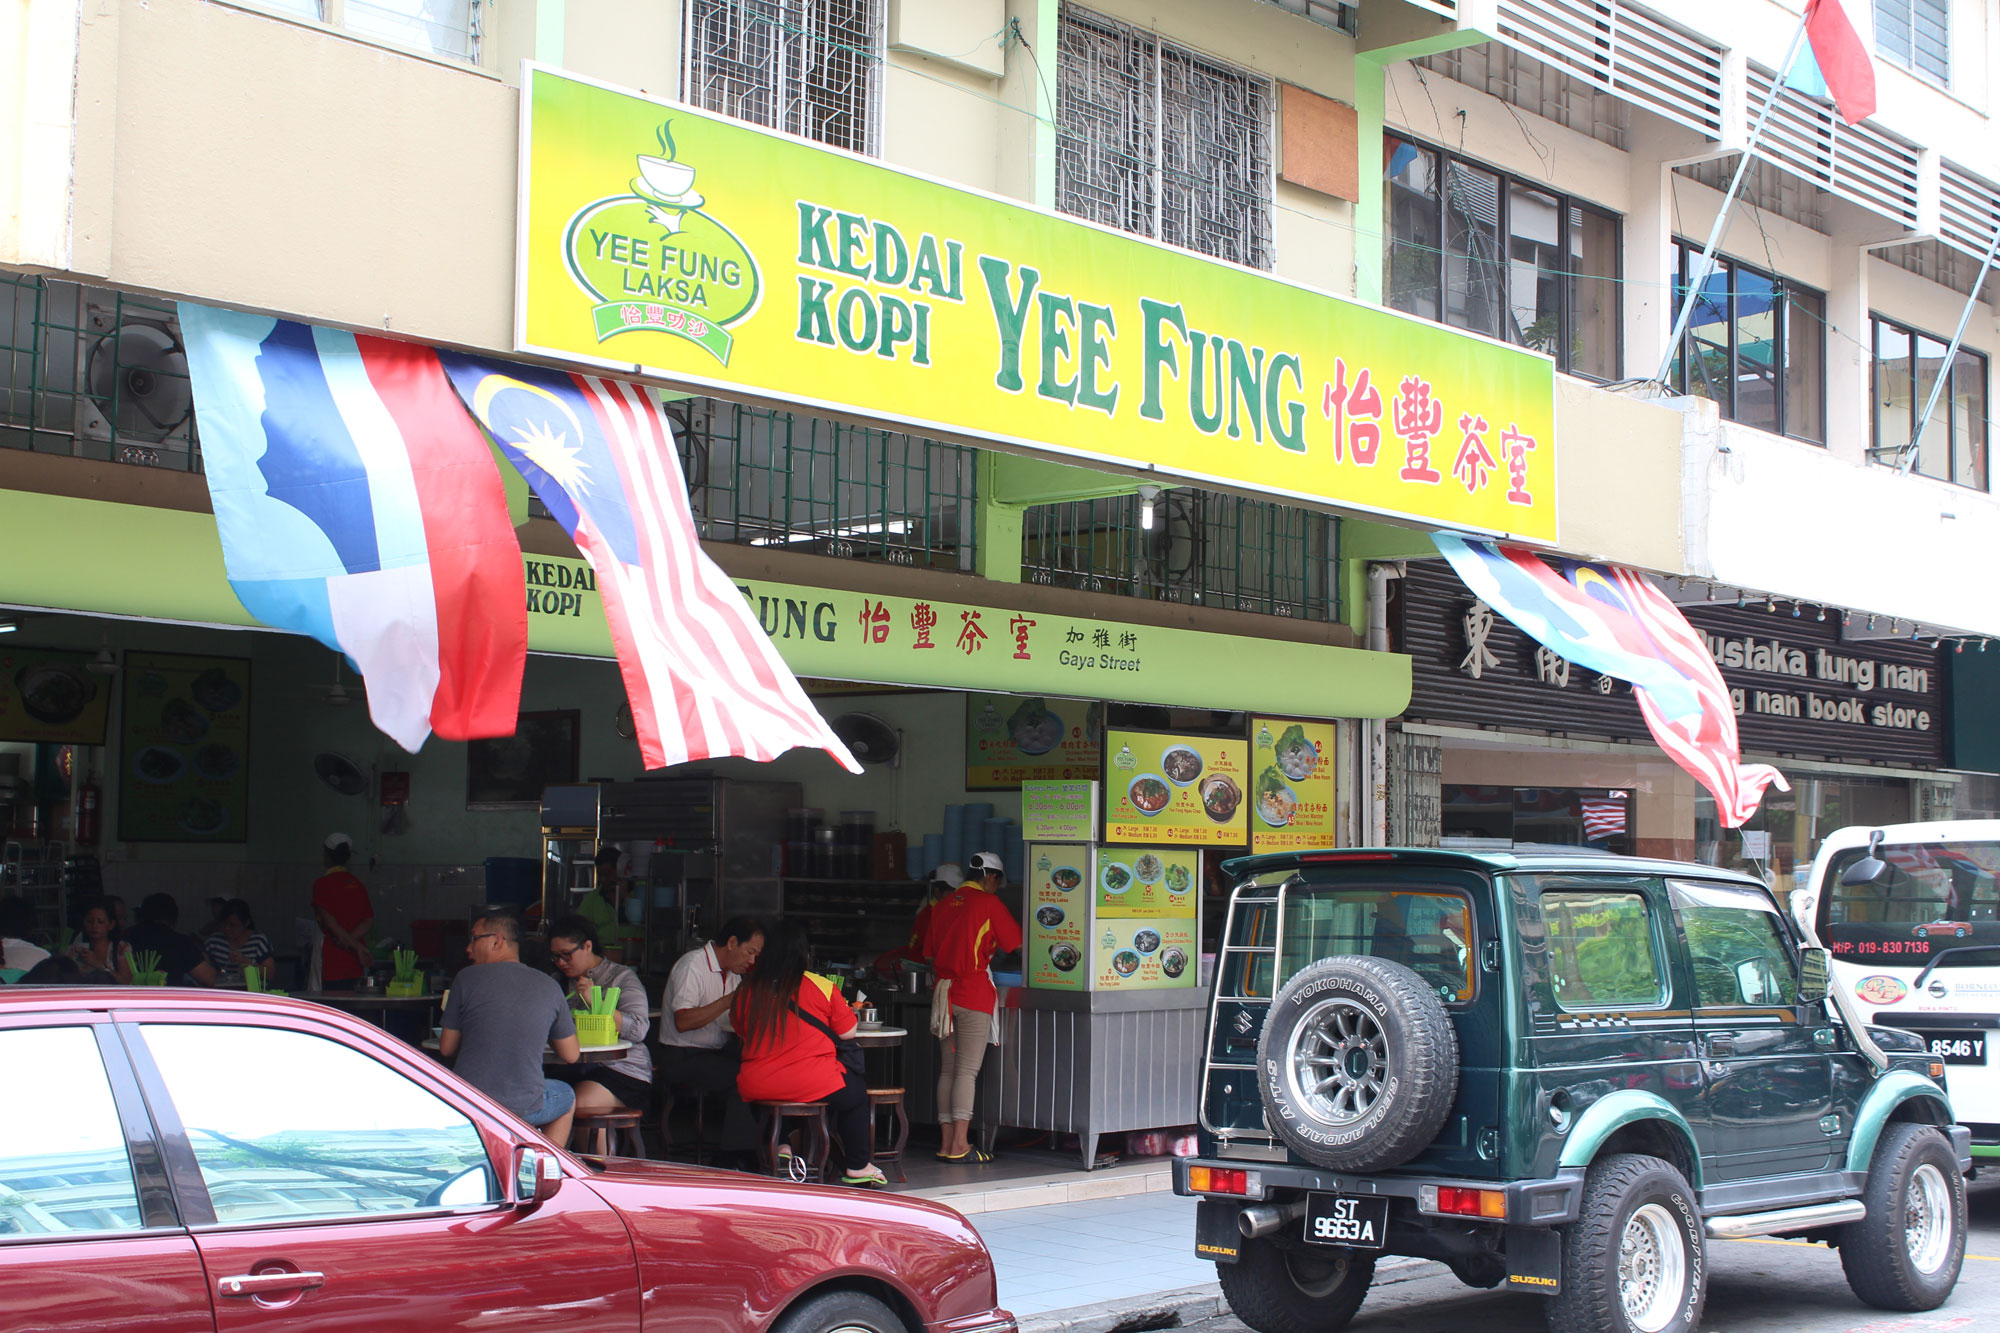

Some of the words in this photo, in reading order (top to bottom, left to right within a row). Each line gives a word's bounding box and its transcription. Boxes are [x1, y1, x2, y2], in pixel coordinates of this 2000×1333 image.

[589, 228, 649, 268] YEE
[660, 244, 742, 286] FUNG
[797, 203, 964, 302] KEDAI
[622, 267, 708, 308] LAKSA
[620, 304, 709, 337] 怡豐叻沙
[796, 276, 931, 366] KOPI
[979, 255, 1119, 418] YEE
[1139, 297, 1307, 453] FUNG
[1323, 356, 1537, 506] 怡豐茶室
[526, 560, 597, 592] KEDAI
[527, 588, 583, 617] KOPI
[736, 585, 838, 642] UNG
[858, 598, 1037, 661] 怡豐茶室
[1065, 625, 1138, 652] 加雅街
[1059, 650, 1096, 669] Gaya
[1099, 653, 1141, 672] Street
[1814, 647, 1876, 692] tung
[1880, 663, 1929, 694] nan
[1752, 689, 1801, 719] nan
[1806, 691, 1866, 725] book
[1871, 701, 1932, 732] store
[1833, 942, 1855, 954] H/P:
[1904, 941, 1930, 953] 7136
[1292, 977, 1388, 1017] YOKOHAMA
[1931, 1040, 1971, 1056] 8546
[1973, 1041, 1983, 1056] Y
[1297, 1076, 1399, 1145] GEOLANDAR
[1334, 1199, 1359, 1219] ST
[1197, 1244, 1237, 1256] SUZUKI
[1671, 1193, 1702, 1323] GOODYEAR
[1509, 1274, 1557, 1287] SUZUKI
